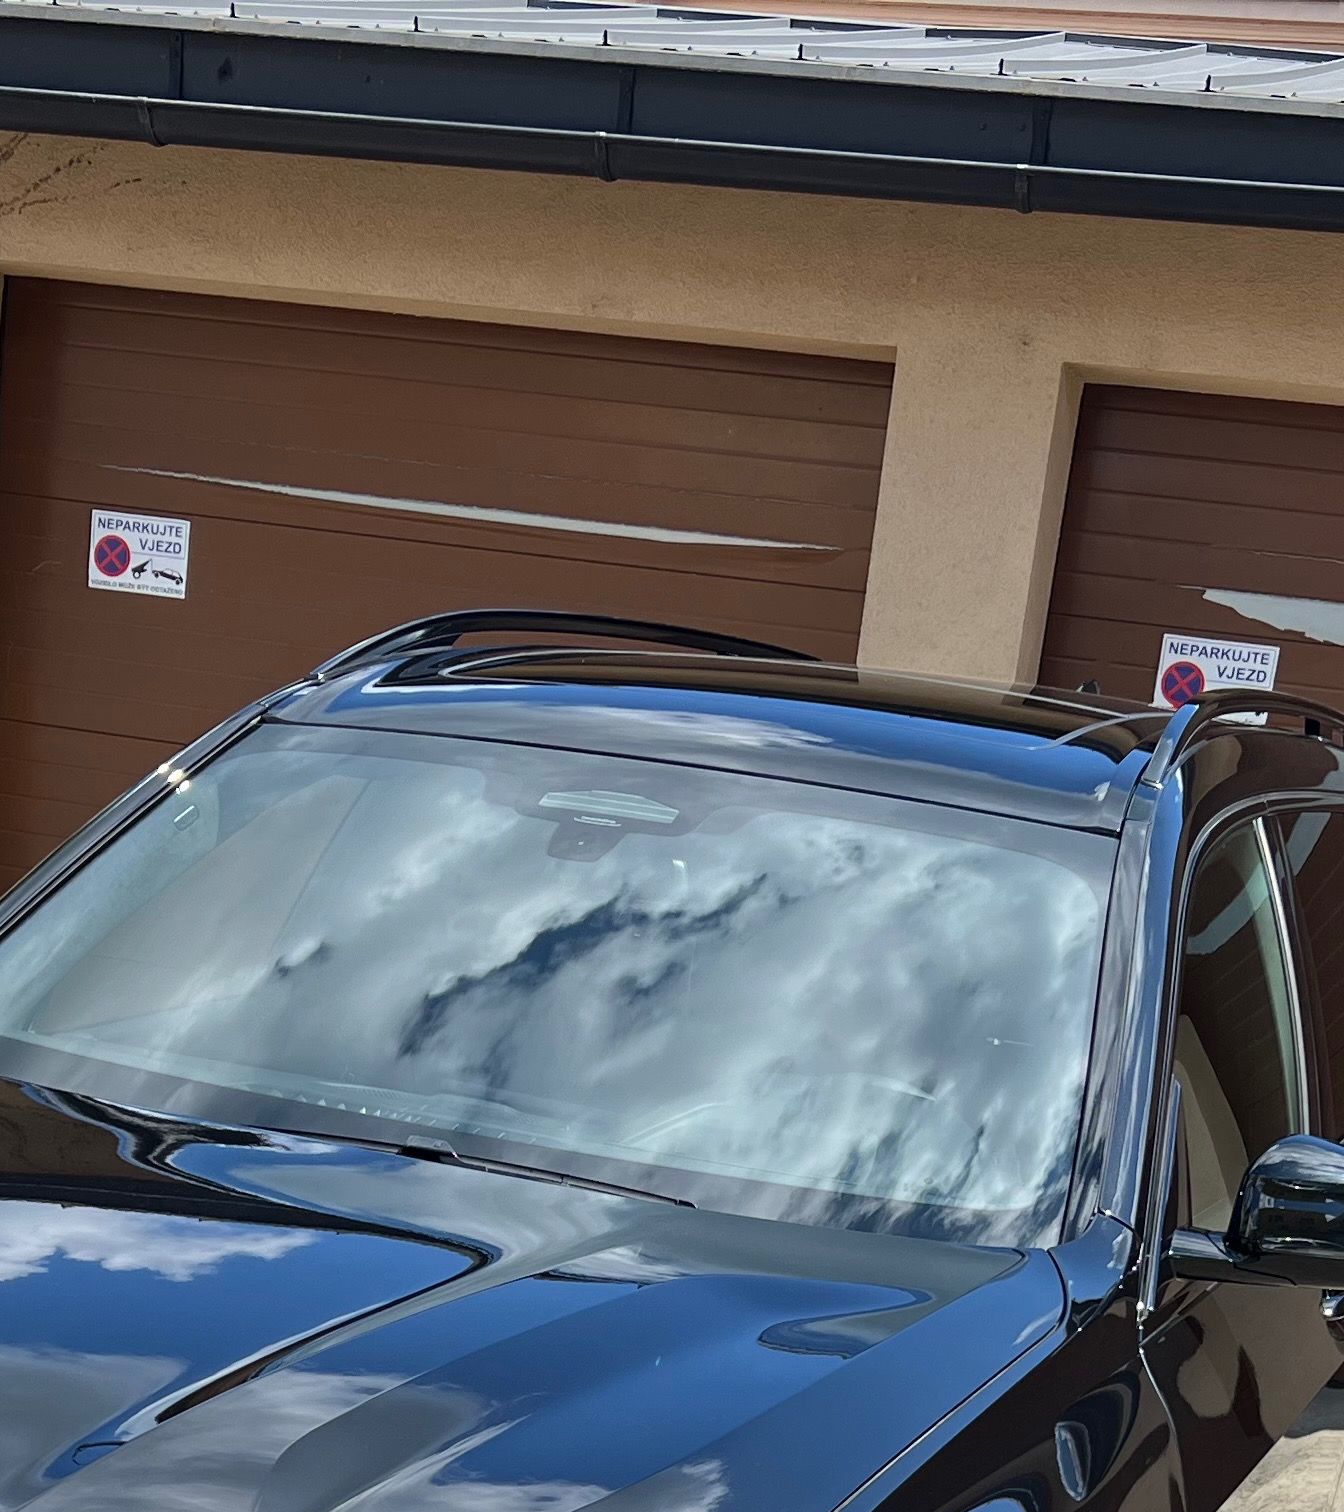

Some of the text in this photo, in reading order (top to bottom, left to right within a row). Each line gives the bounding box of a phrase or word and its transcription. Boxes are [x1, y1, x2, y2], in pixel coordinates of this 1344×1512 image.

[97, 516, 184, 538] NEPARKUJTE
[138, 538, 183, 555] VJEZD
[1168, 641, 1271, 666] NEPARKUJTE
[1216, 664, 1268, 684] VJEZD
